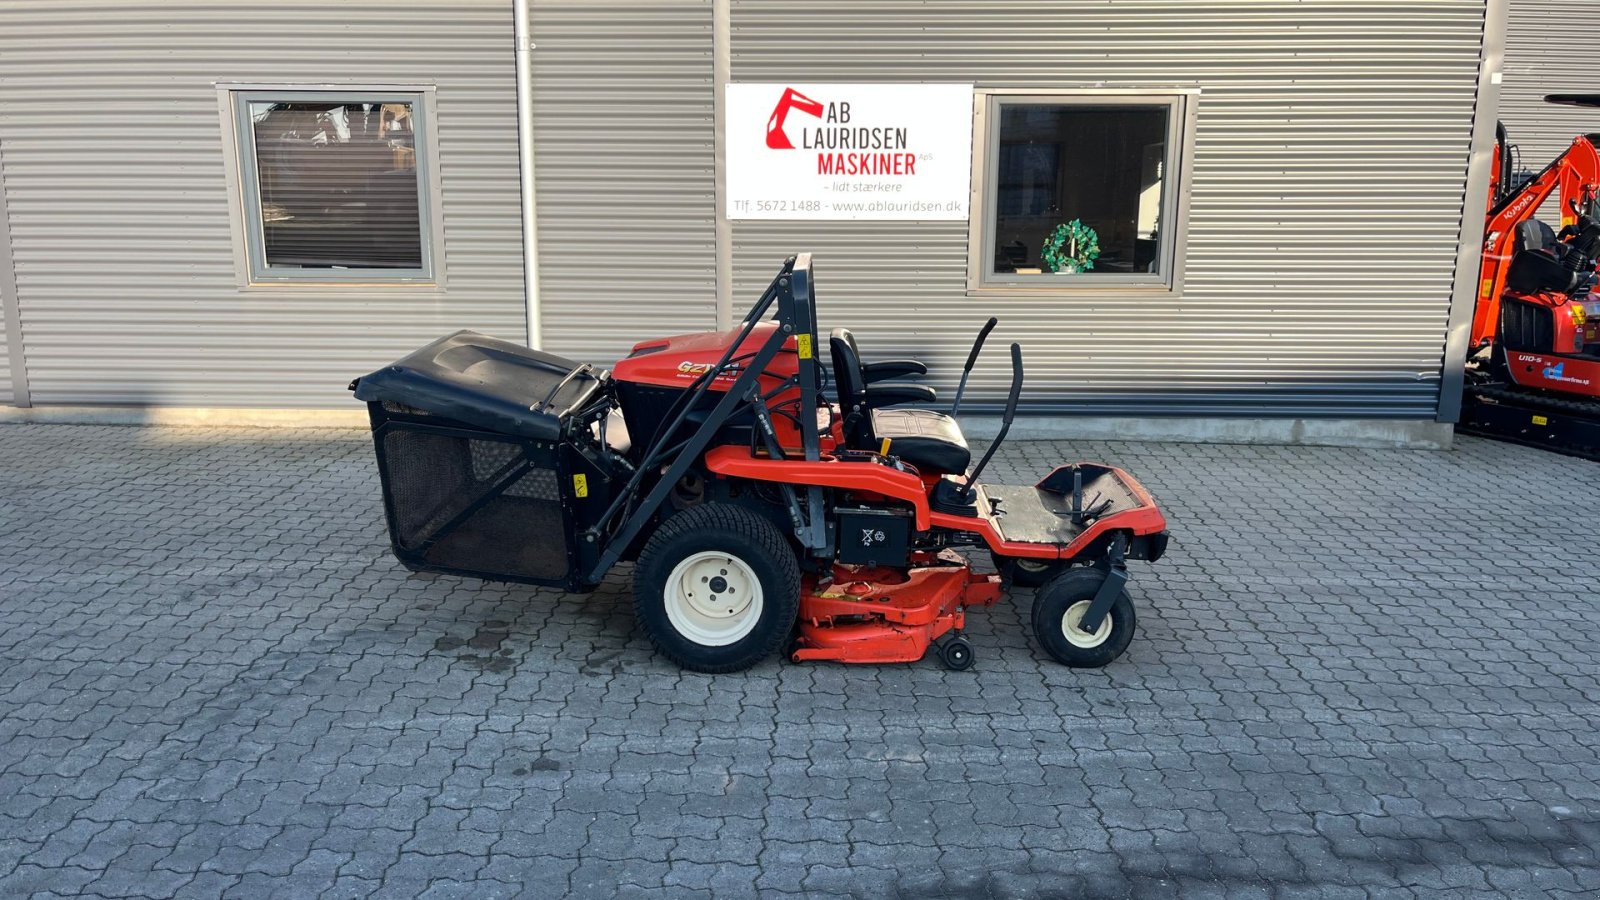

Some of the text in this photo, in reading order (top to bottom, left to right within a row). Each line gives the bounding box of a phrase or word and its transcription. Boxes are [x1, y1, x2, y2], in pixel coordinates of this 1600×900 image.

[827, 102, 851, 124] AB
[803, 127, 907, 150] LAURIDSEN
[818, 152, 934, 176] MASKINER ApS
[832, 181, 850, 193] lidt
[852, 181, 903, 193] stærkere
[734, 199, 753, 215] Tlf.
[757, 199, 788, 212] 5672
[790, 200, 821, 212] 1488
[832, 200, 962, 213] www.ablauridsen.dk
[1503, 194, 1535, 220] Kubota
